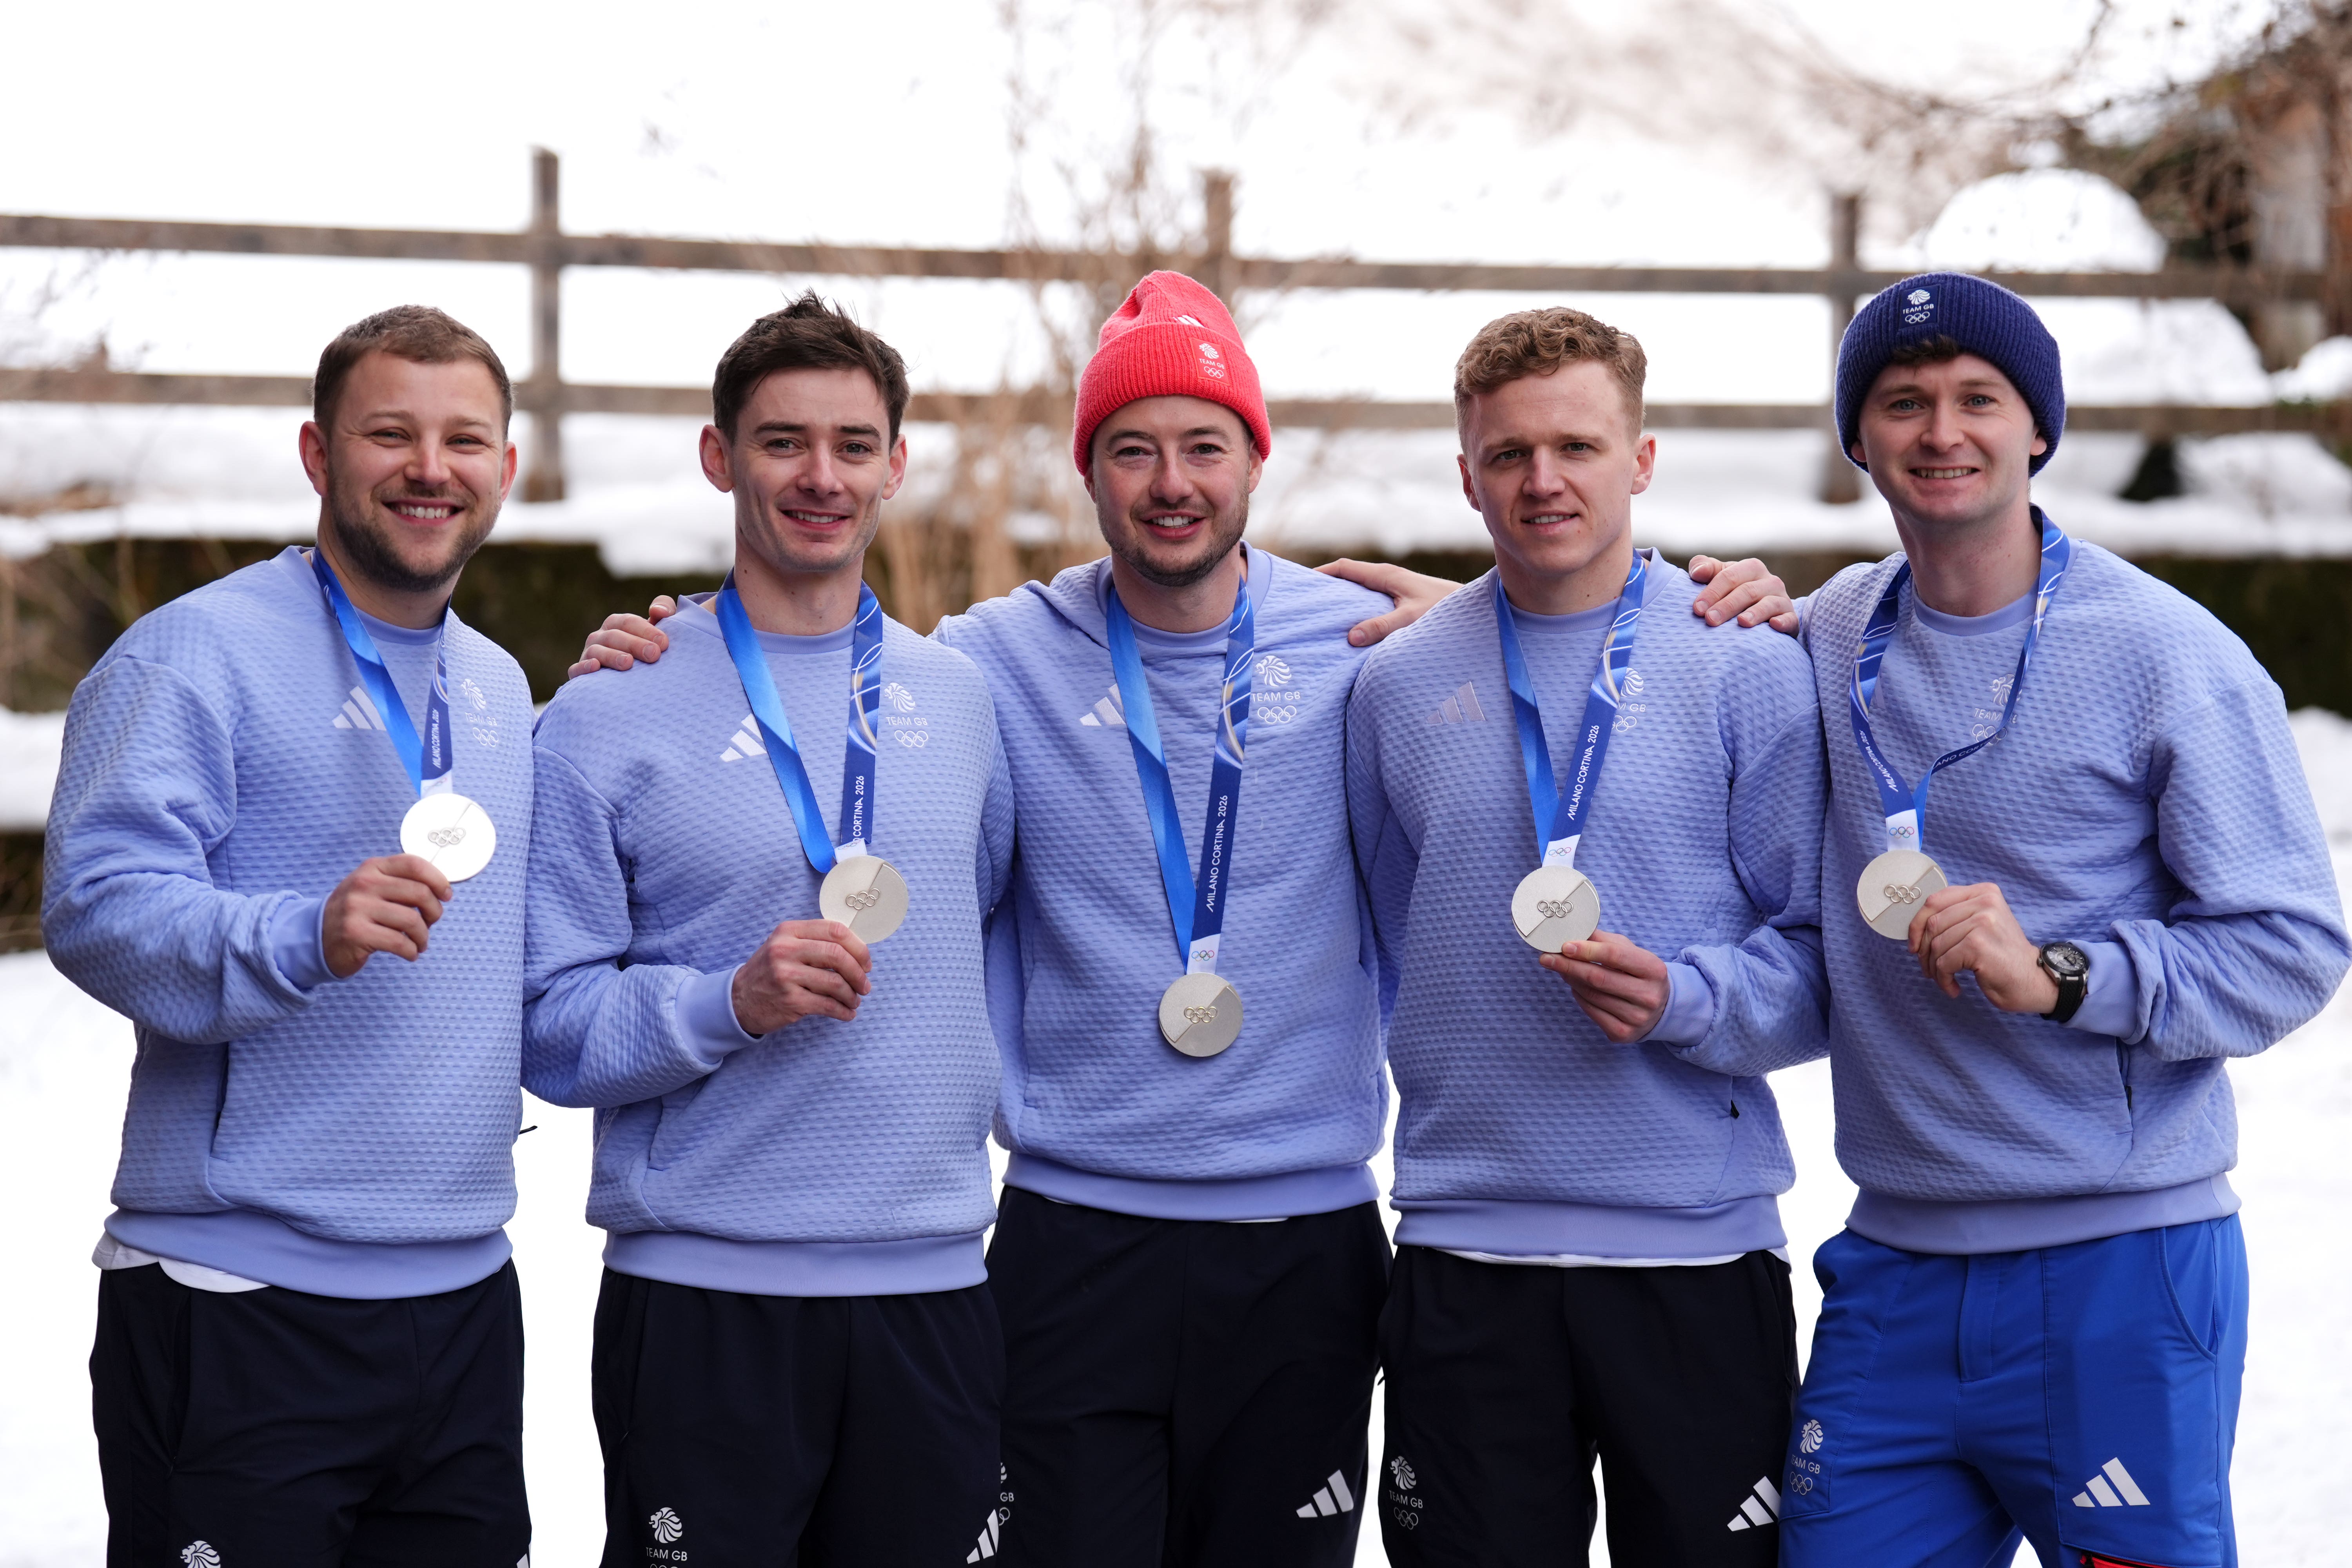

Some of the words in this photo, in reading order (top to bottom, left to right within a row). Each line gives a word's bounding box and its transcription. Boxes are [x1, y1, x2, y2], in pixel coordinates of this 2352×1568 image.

[1251, 692, 1281, 702] TEAM
[1285, 691, 1301, 700] GB
[1630, 703, 1646, 712] GB
[1974, 708, 2002, 721] TEAM
[465, 712, 485, 724] TEAM
[486, 716, 498, 726] GB
[886, 717, 912, 725] TEAM
[432, 723, 440, 746] CORTINA
[432, 746, 441, 769] MILANO
[1865, 746, 1884, 767] CORTINA
[1935, 755, 1957, 768] ANO
[1567, 784, 1584, 820] MILANO
[1577, 745, 1595, 784] CORTINA
[1588, 725, 1600, 744] 2026
[1878, 767, 1899, 792] MILANO
[855, 775, 864, 795] 2026
[1218, 795, 1228, 817] 2026
[853, 797, 864, 837] CORTINA
[1212, 819, 1225, 866] CORTINA
[1206, 867, 1219, 913] MILANO
[1791, 1454, 1806, 1469] TEAM
[1808, 1462, 1820, 1474] GB
[1000, 1492, 1014, 1502] GB
[1389, 1490, 1408, 1505] TEAM
[1410, 1497, 1423, 1508] GB
[646, 1547, 668, 1559] TEAM
[671, 1550, 688, 1561] GB
